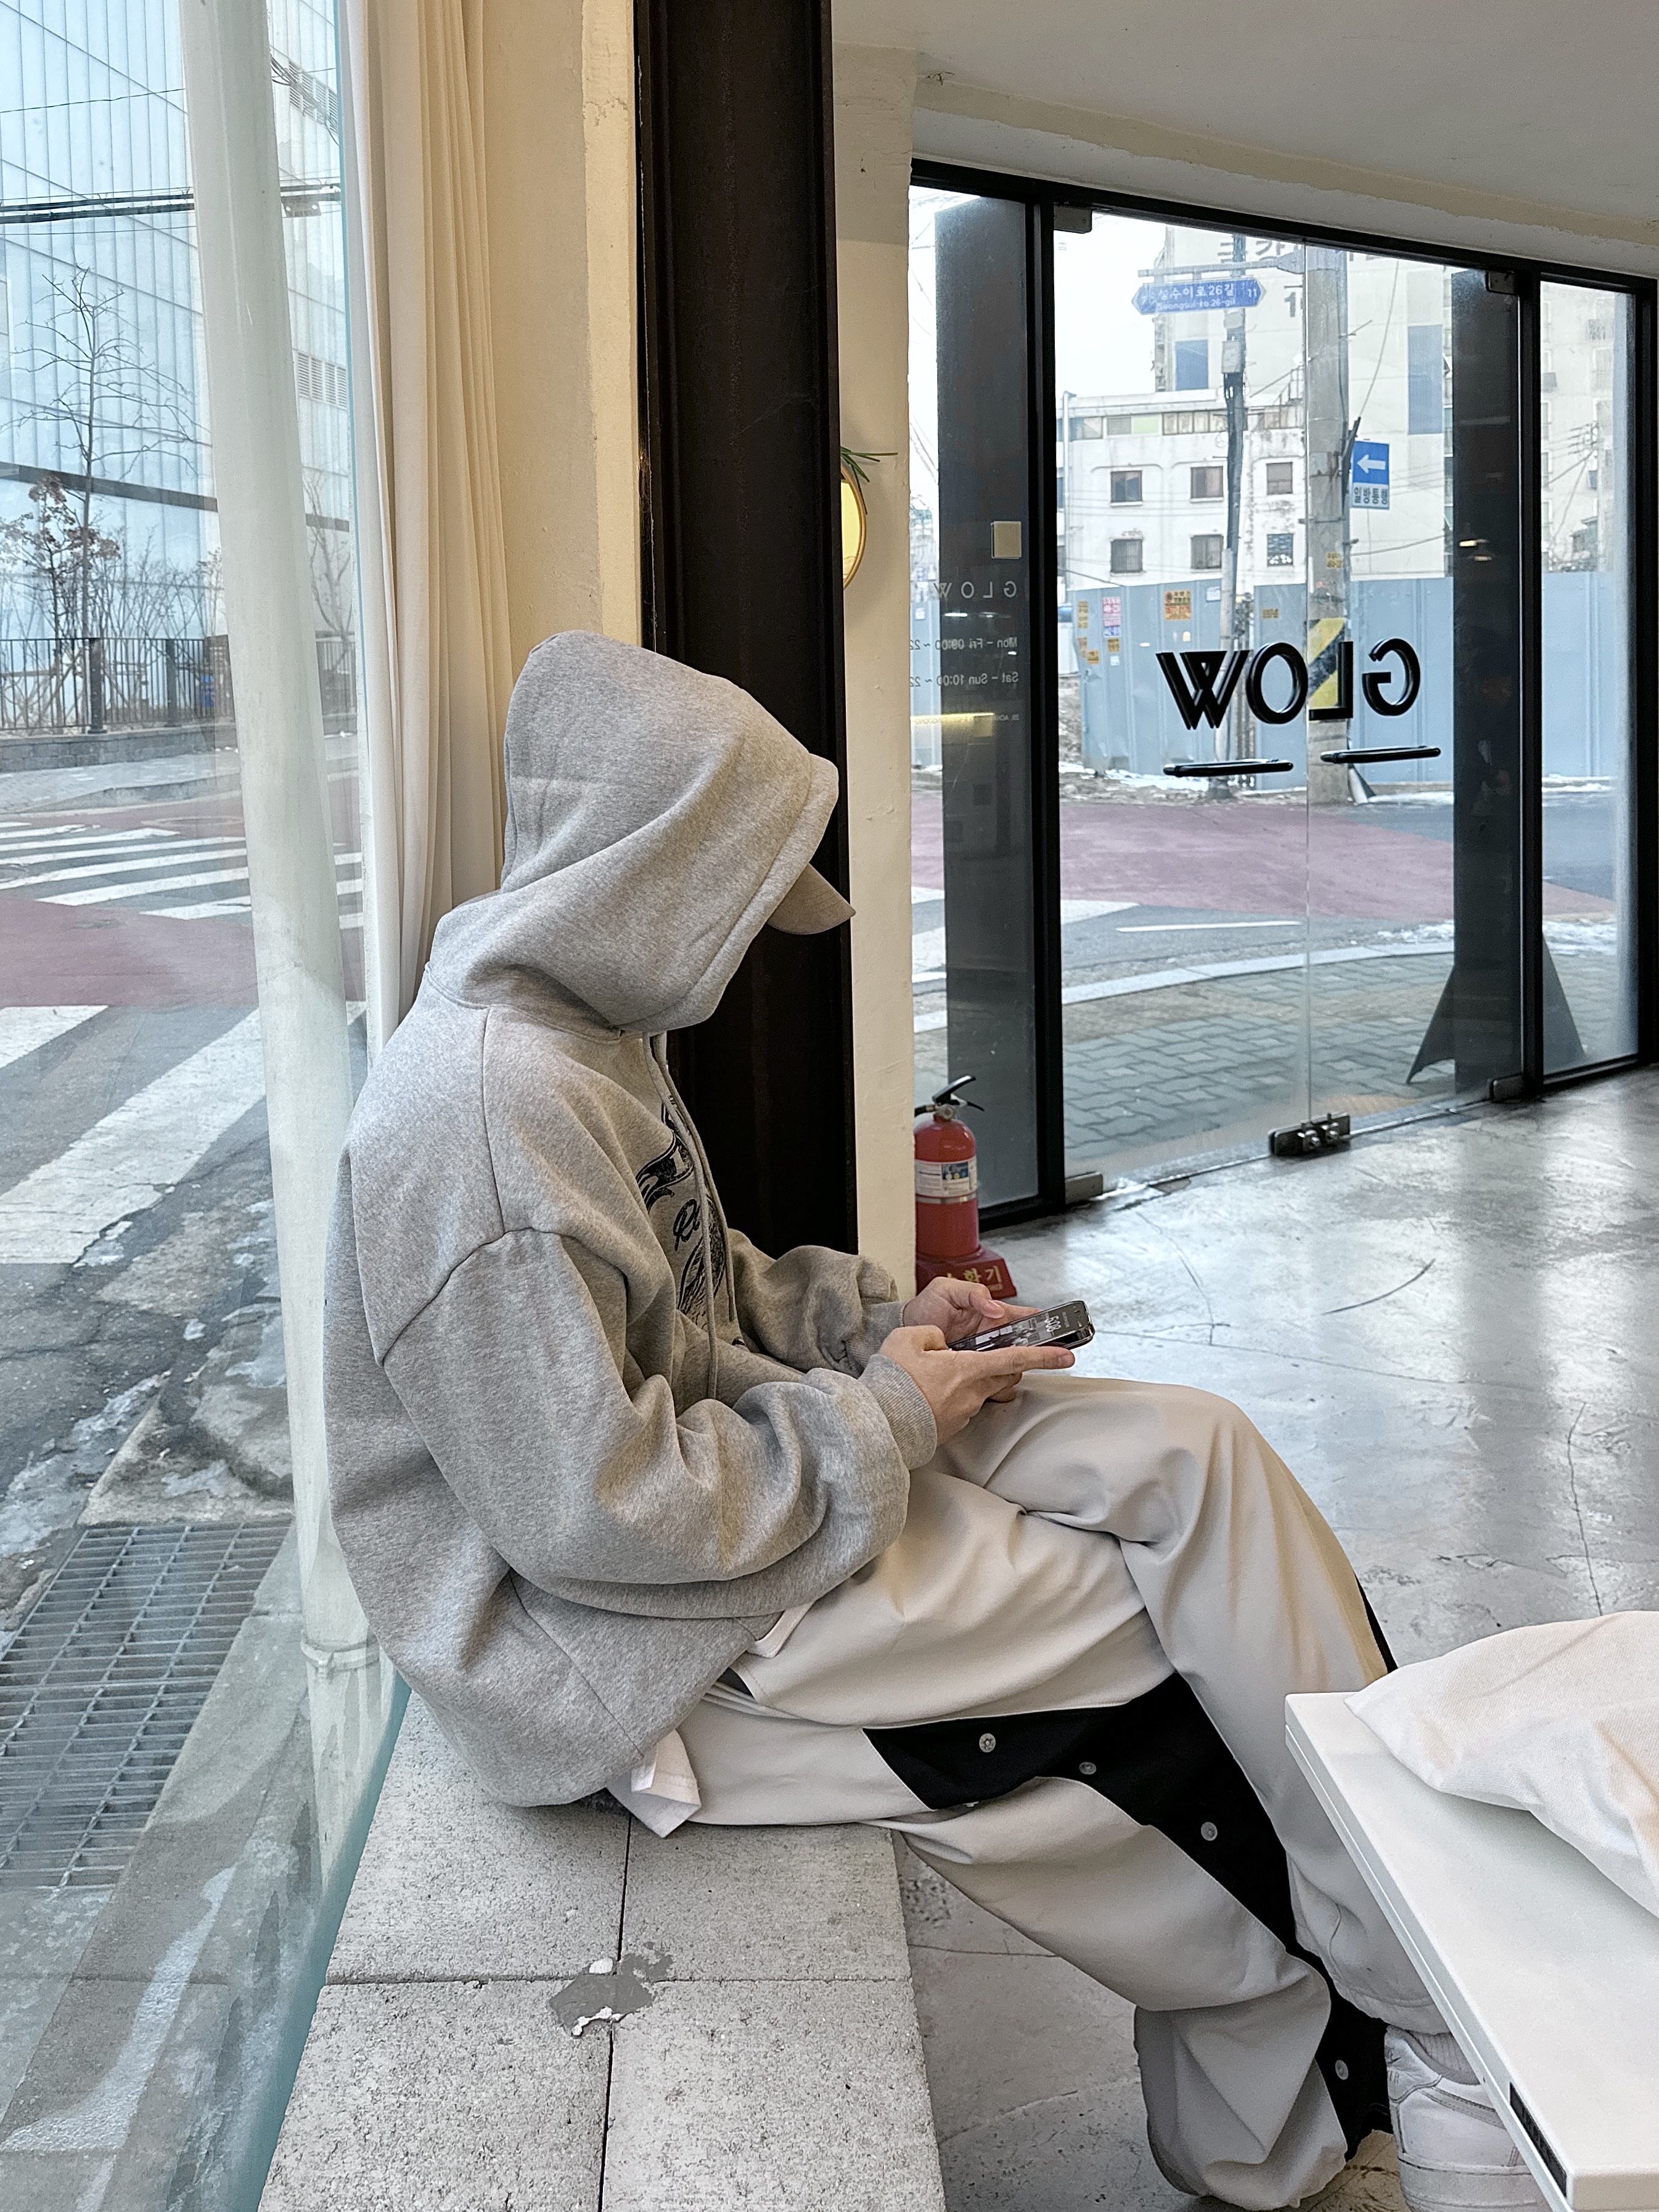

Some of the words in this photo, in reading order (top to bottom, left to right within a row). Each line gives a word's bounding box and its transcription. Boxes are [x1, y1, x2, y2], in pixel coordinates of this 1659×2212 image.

[1157, 283, 1234, 301] 성수이로26길
[1248, 288, 1257, 297] 11
[1353, 486, 1388, 506] 일방통행
[946, 1264, 1002, 1283] 화기
